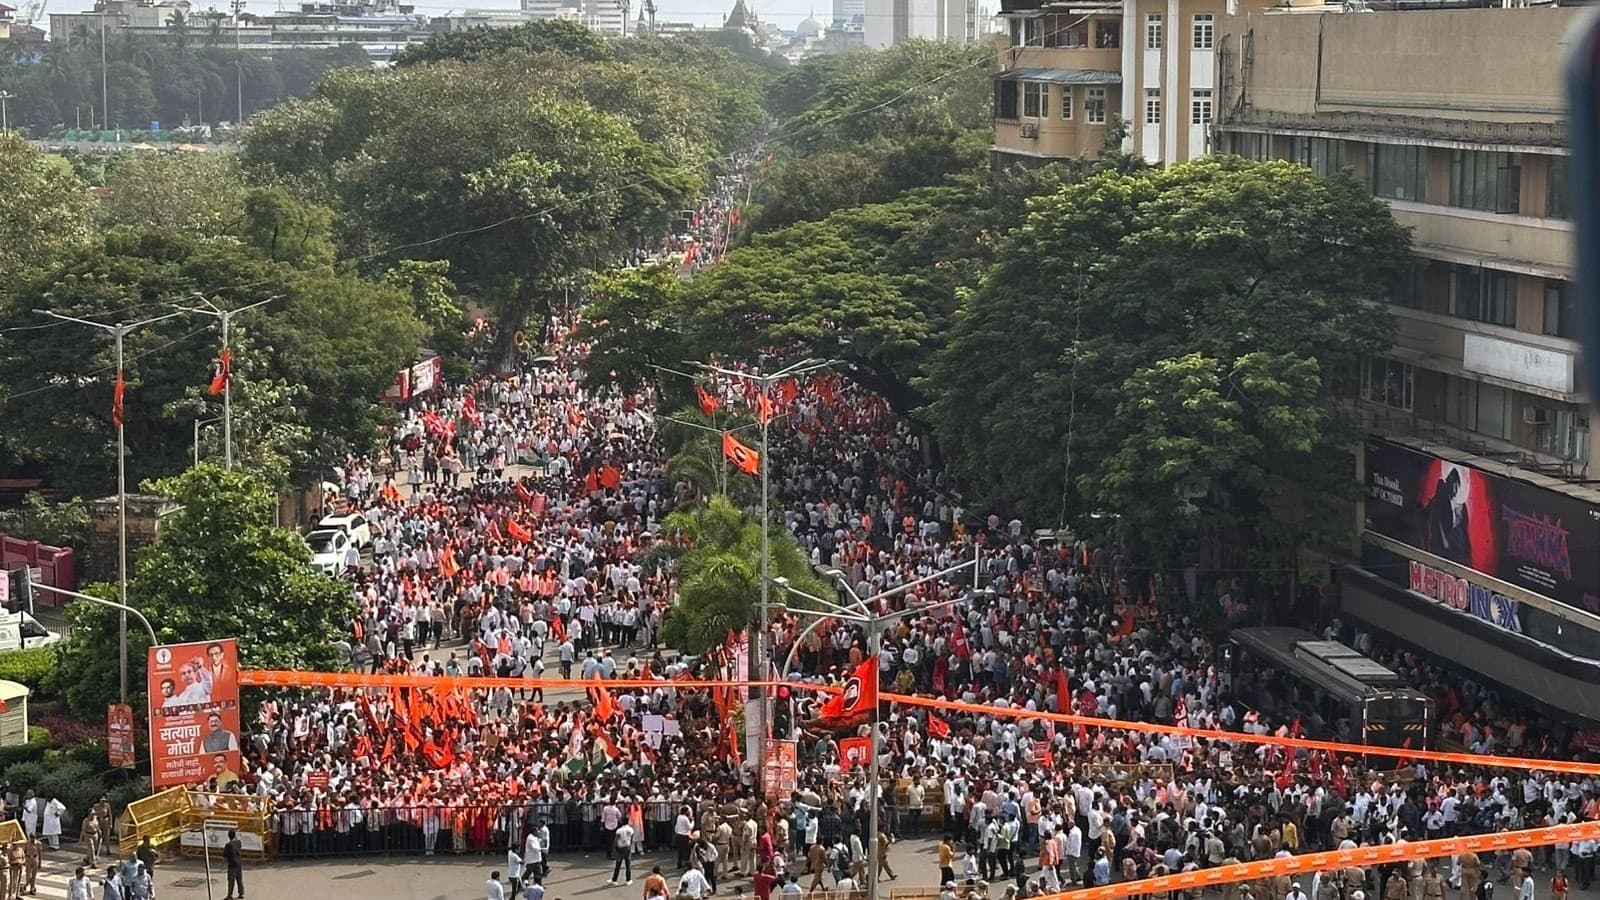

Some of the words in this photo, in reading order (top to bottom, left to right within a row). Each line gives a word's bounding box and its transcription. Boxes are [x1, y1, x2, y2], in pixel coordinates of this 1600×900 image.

[1409, 560, 1469, 610] METRO
[1470, 583, 1522, 632] INOX
[159, 724, 201, 741] सत्याचा
[166, 738, 196, 756] मोर्चा
